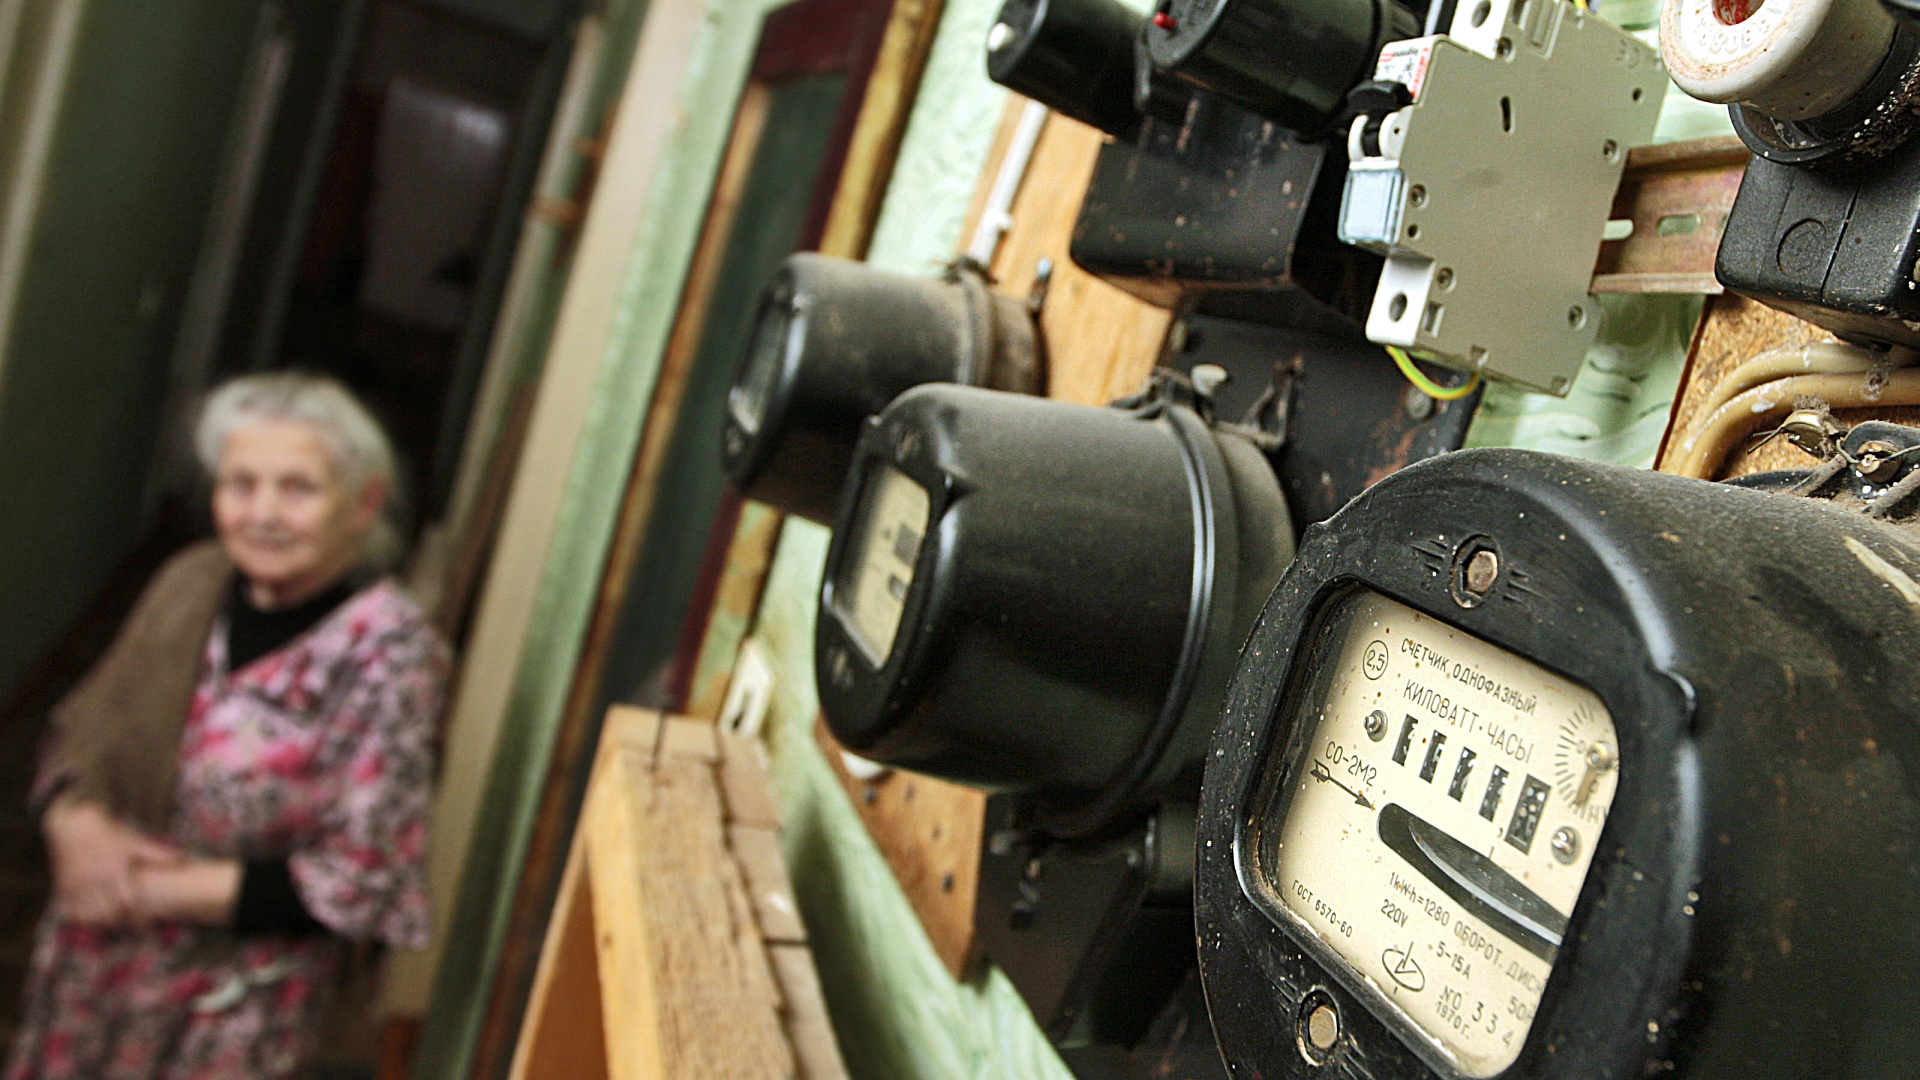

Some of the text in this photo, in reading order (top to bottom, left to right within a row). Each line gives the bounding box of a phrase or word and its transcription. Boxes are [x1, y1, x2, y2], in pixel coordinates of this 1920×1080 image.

[1366, 649, 1385, 671] 2,5
[1401, 637, 1538, 716] СЧЕТЧИК ОДНОФАЗНЫЙ
[1325, 740, 1377, 787] СО-2М2
[1292, 879, 1354, 938] ГОСТ 6570-60
[1380, 898, 1409, 928] 220V
